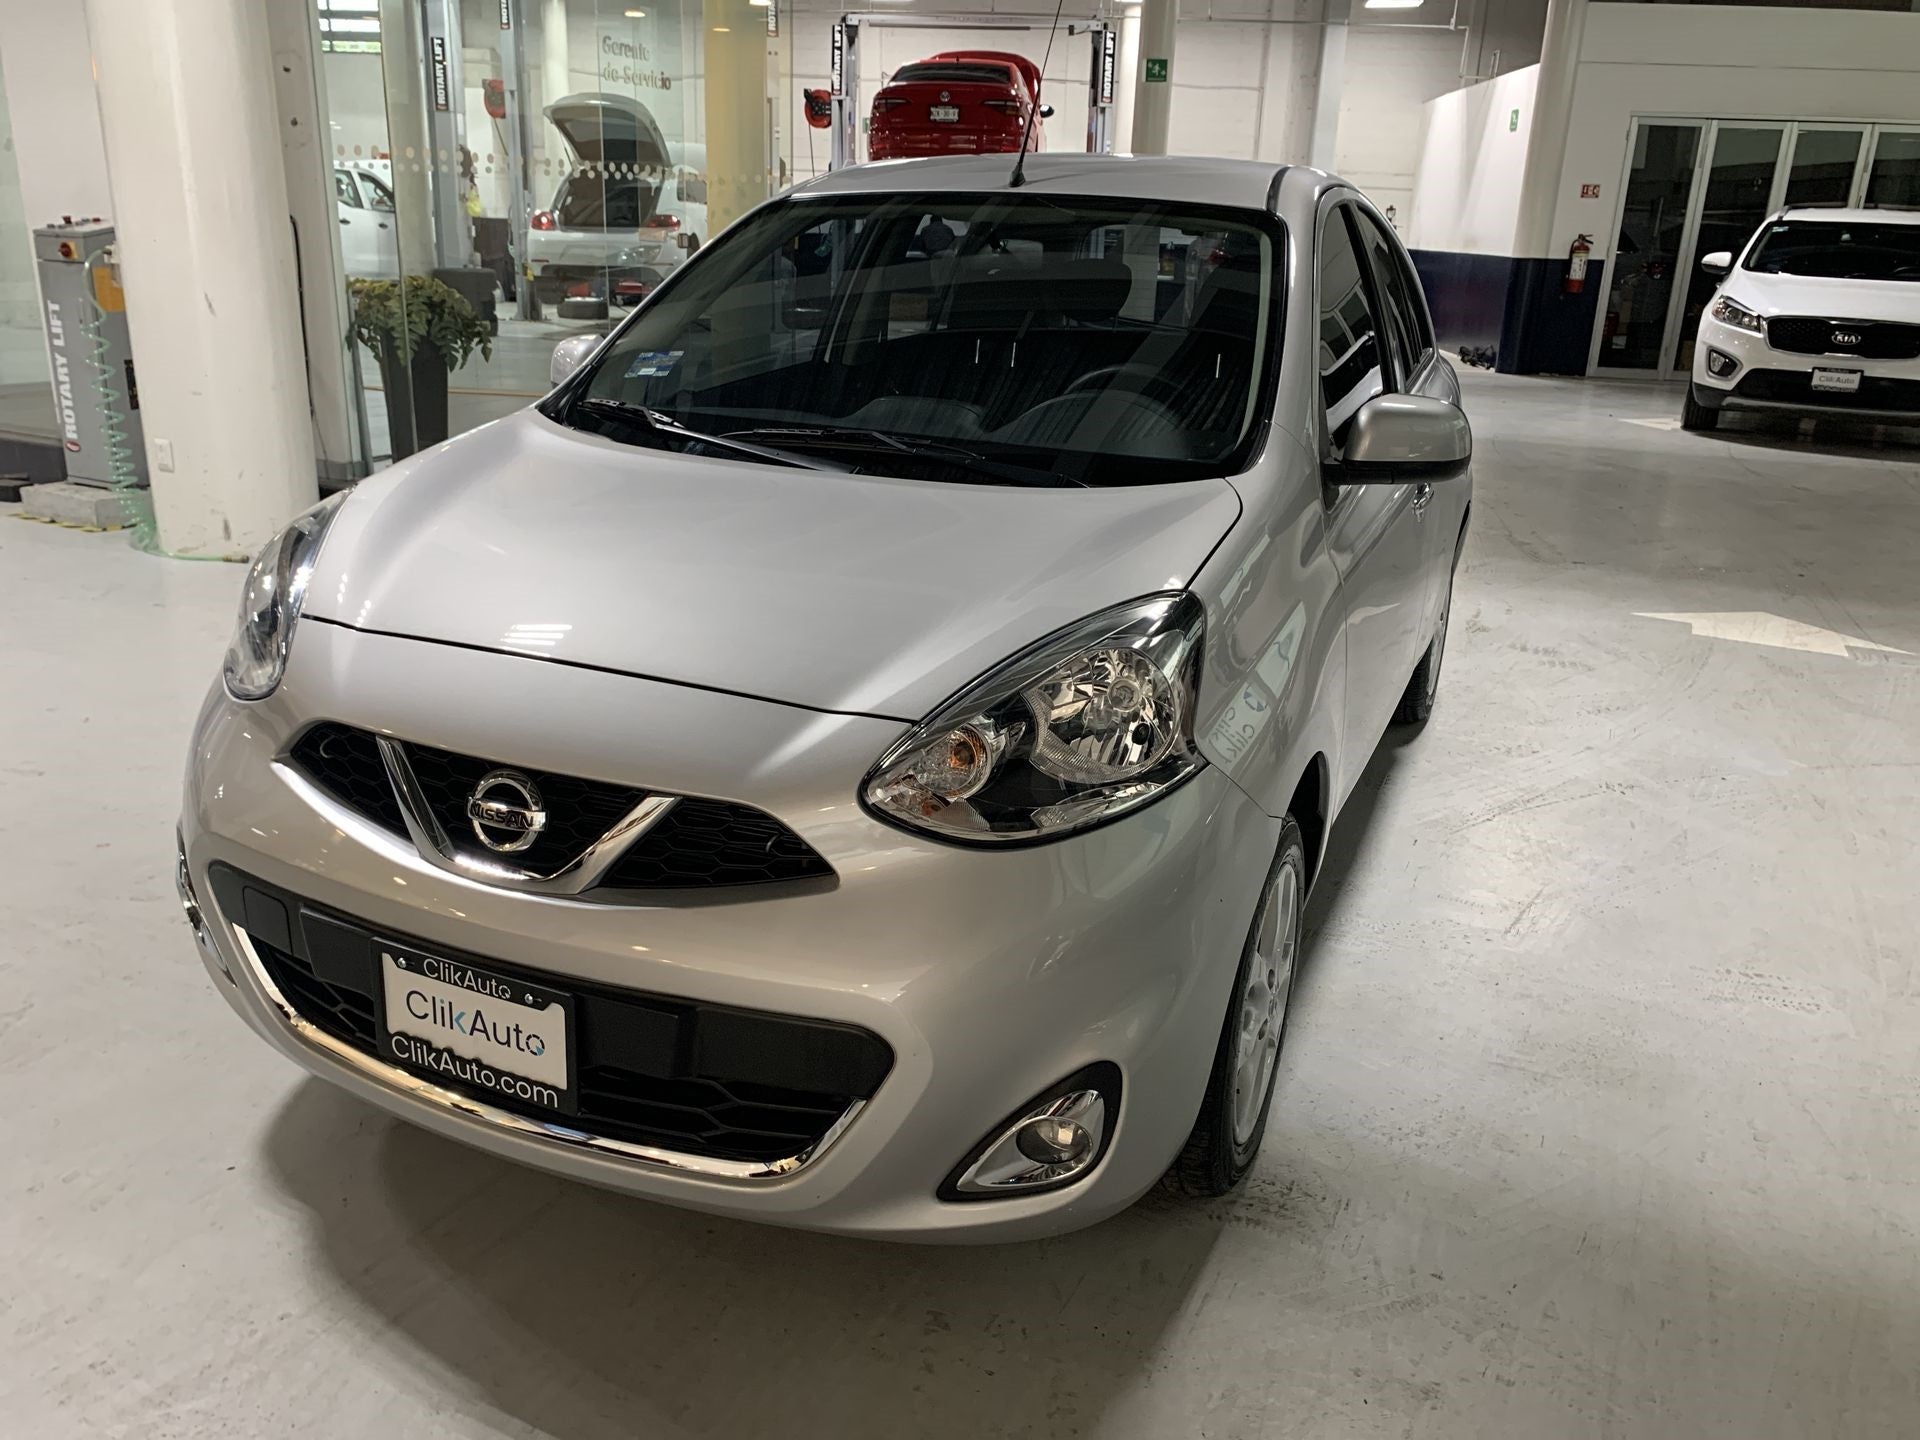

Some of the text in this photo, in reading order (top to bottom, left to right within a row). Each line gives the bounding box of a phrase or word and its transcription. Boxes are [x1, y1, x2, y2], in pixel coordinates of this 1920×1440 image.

[433, 38, 446, 104] ROTARY LIFT
[602, 35, 651, 61] Gerente
[603, 62, 671, 90] de Servicio
[833, 25, 842, 90] ROTARY LIFT
[1103, 32, 1114, 97] ROTARY LIFT
[48, 300, 78, 440] ROTARY LIFT
[470, 802, 534, 830] NISSAN
[423, 958, 512, 1000] ClikAuto
[406, 990, 545, 1056] ClikAuto
[391, 1035, 558, 1108] ClikAuto.com
